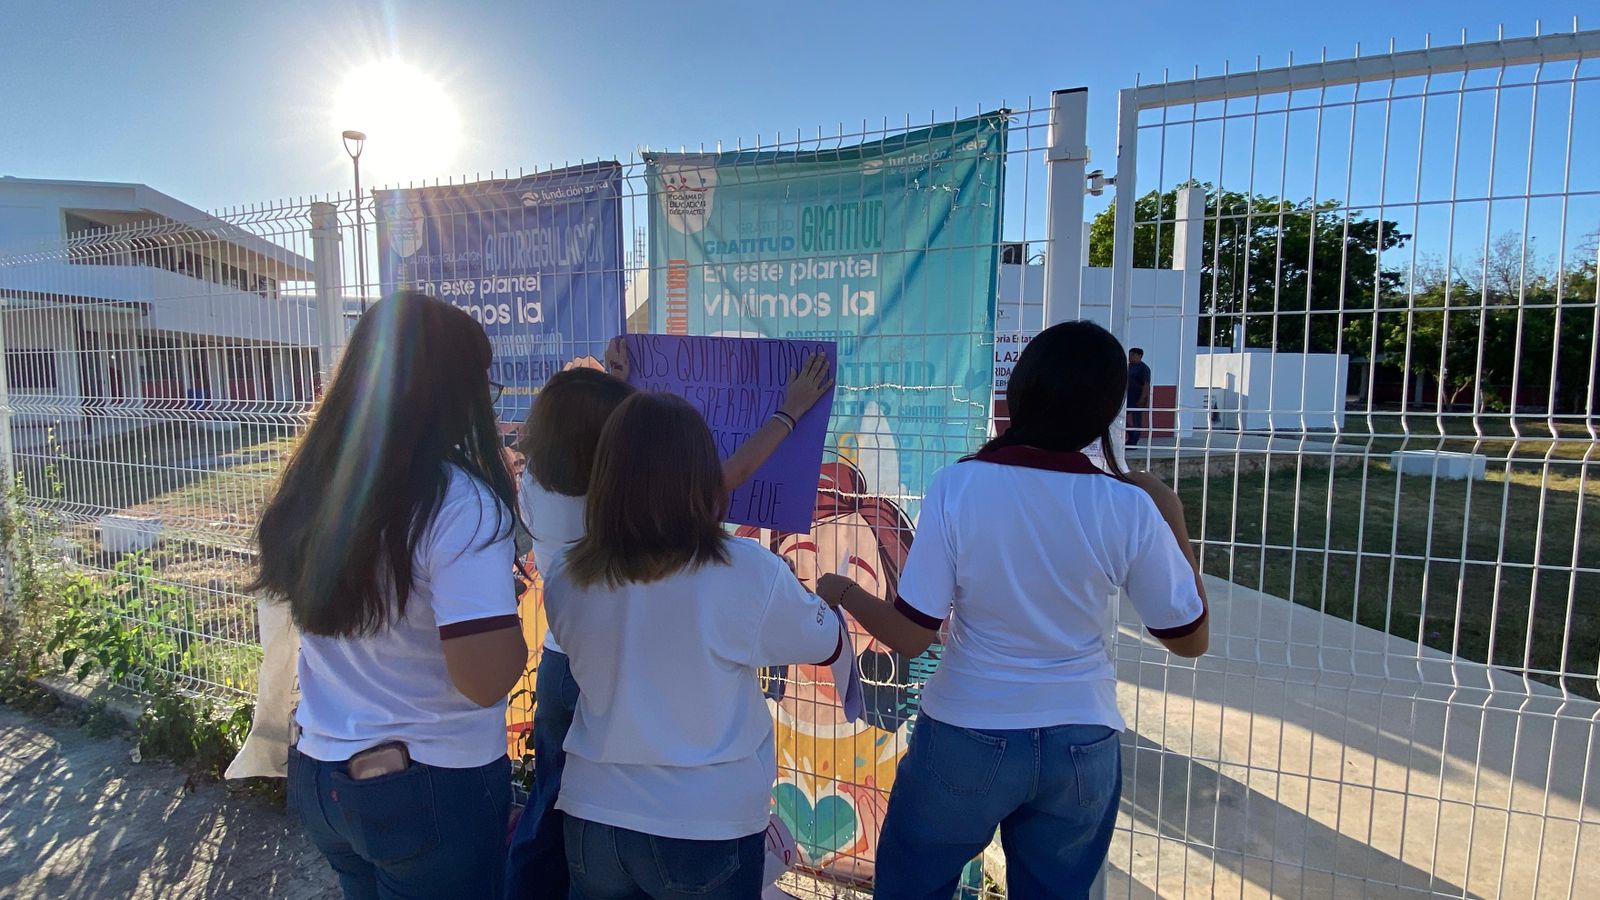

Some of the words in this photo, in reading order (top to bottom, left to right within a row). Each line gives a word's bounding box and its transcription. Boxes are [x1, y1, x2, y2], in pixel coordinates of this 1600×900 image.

[703, 236, 796, 255] GRATITUD
[704, 261, 727, 283] En
[733, 261, 784, 282] este
[790, 254, 878, 286] plantel
[416, 279, 436, 297] En
[440, 278, 475, 296] este
[480, 271, 542, 300] plantel
[518, 297, 544, 324] la
[703, 288, 832, 318] vivimos
[842, 284, 876, 317] la
[628, 335, 670, 379] NOS
[676, 338, 760, 386] QUITARON
[1003, 351, 1020, 362] AZ
[747, 479, 785, 525] FUE
